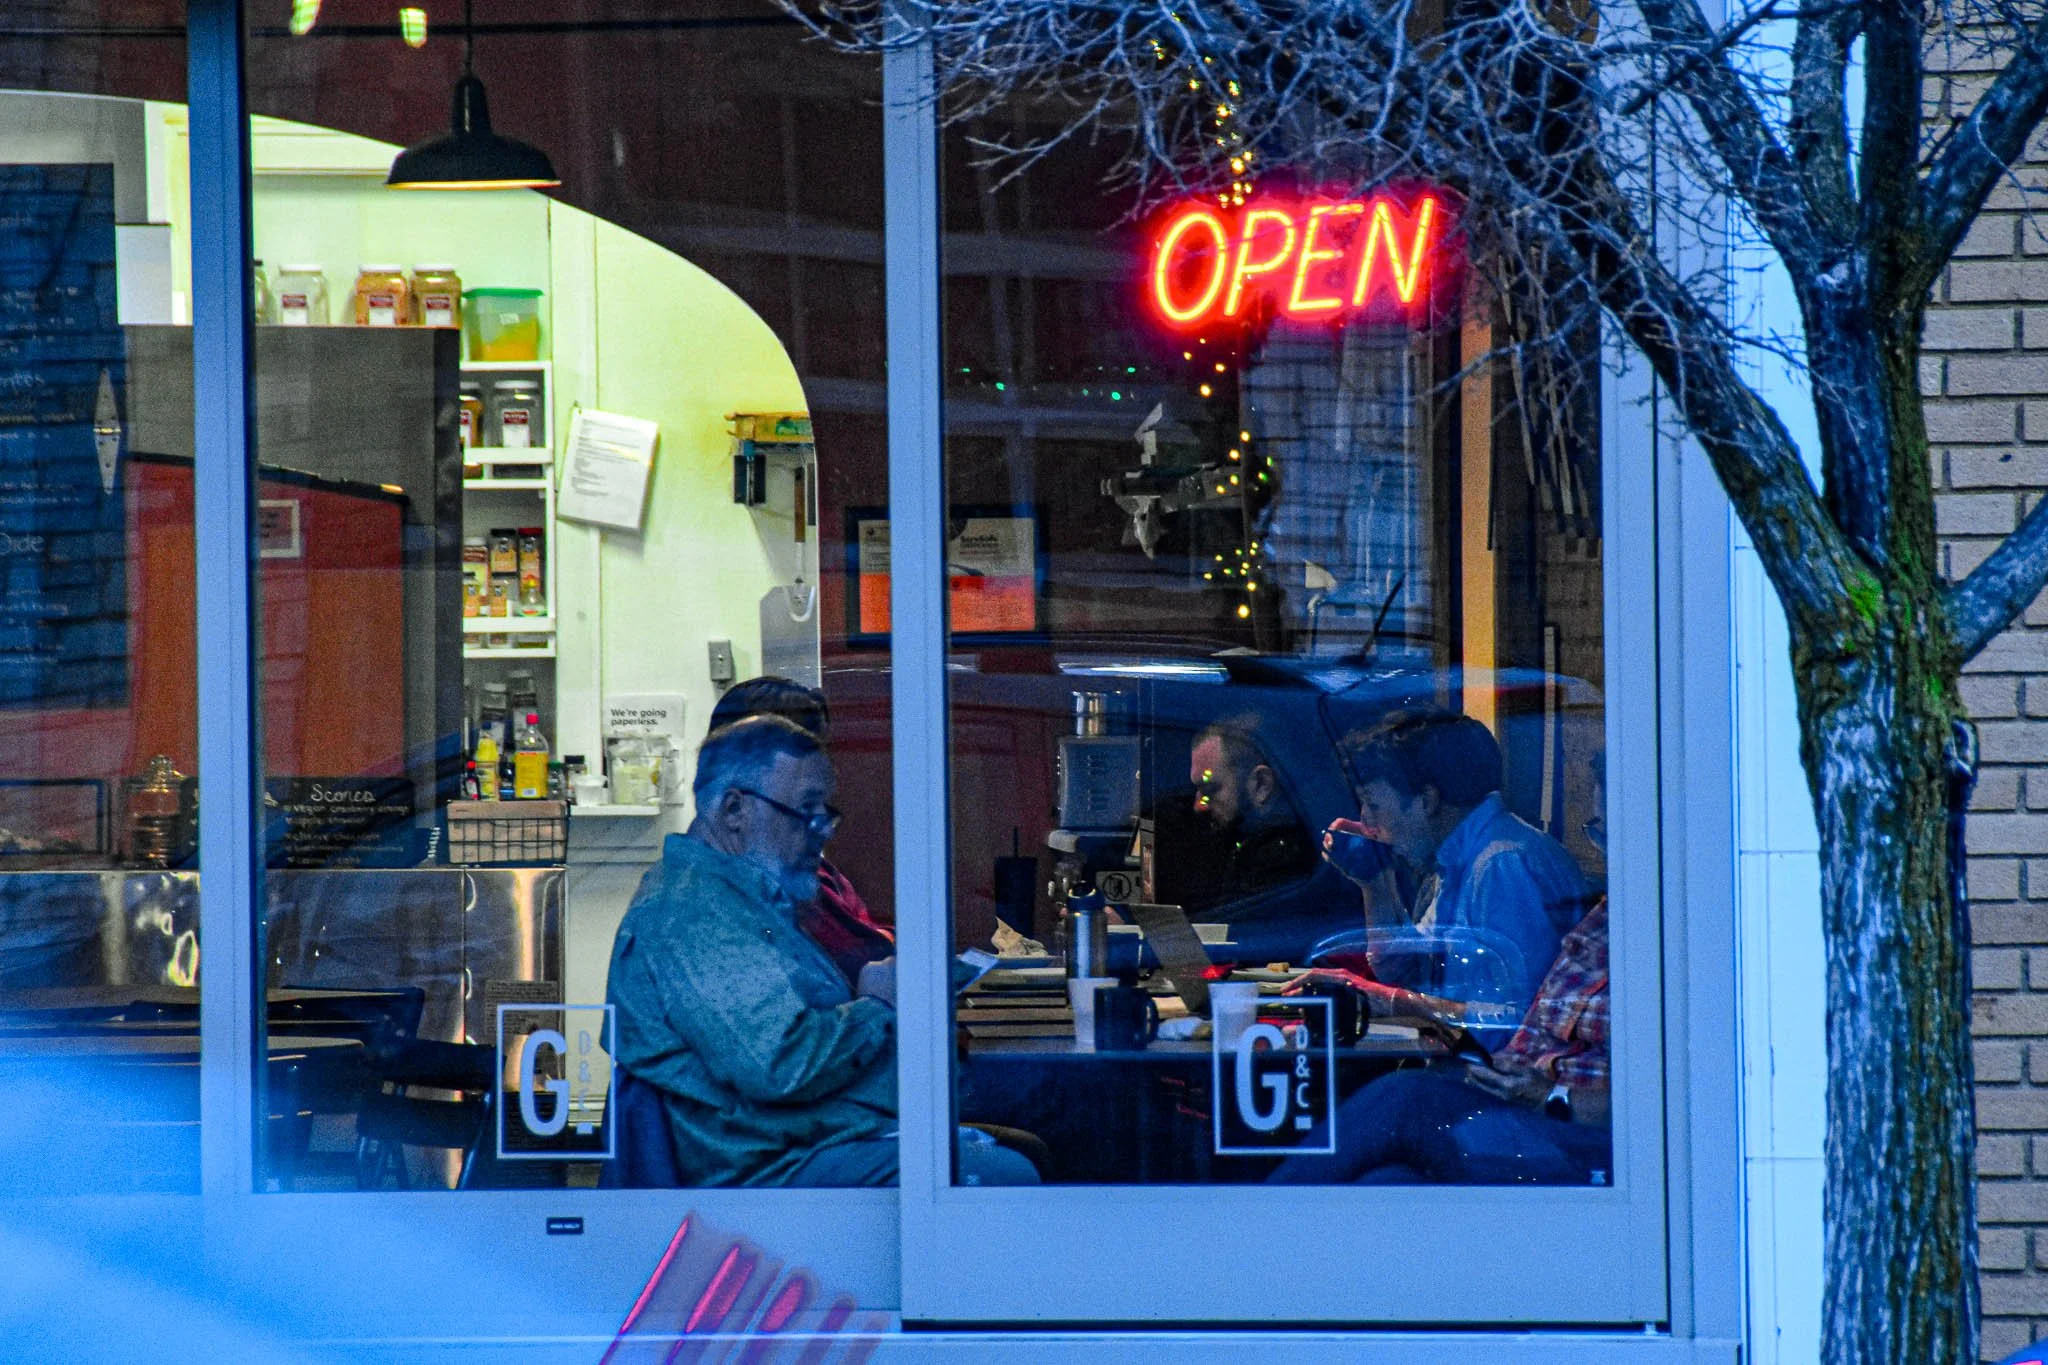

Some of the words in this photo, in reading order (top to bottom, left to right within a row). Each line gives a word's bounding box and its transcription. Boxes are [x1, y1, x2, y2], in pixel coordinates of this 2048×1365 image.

[1155, 197, 1434, 322] OPEN
[610, 708, 637, 717] We're
[640, 708, 667, 718] going
[610, 718, 659, 726] paperless.
